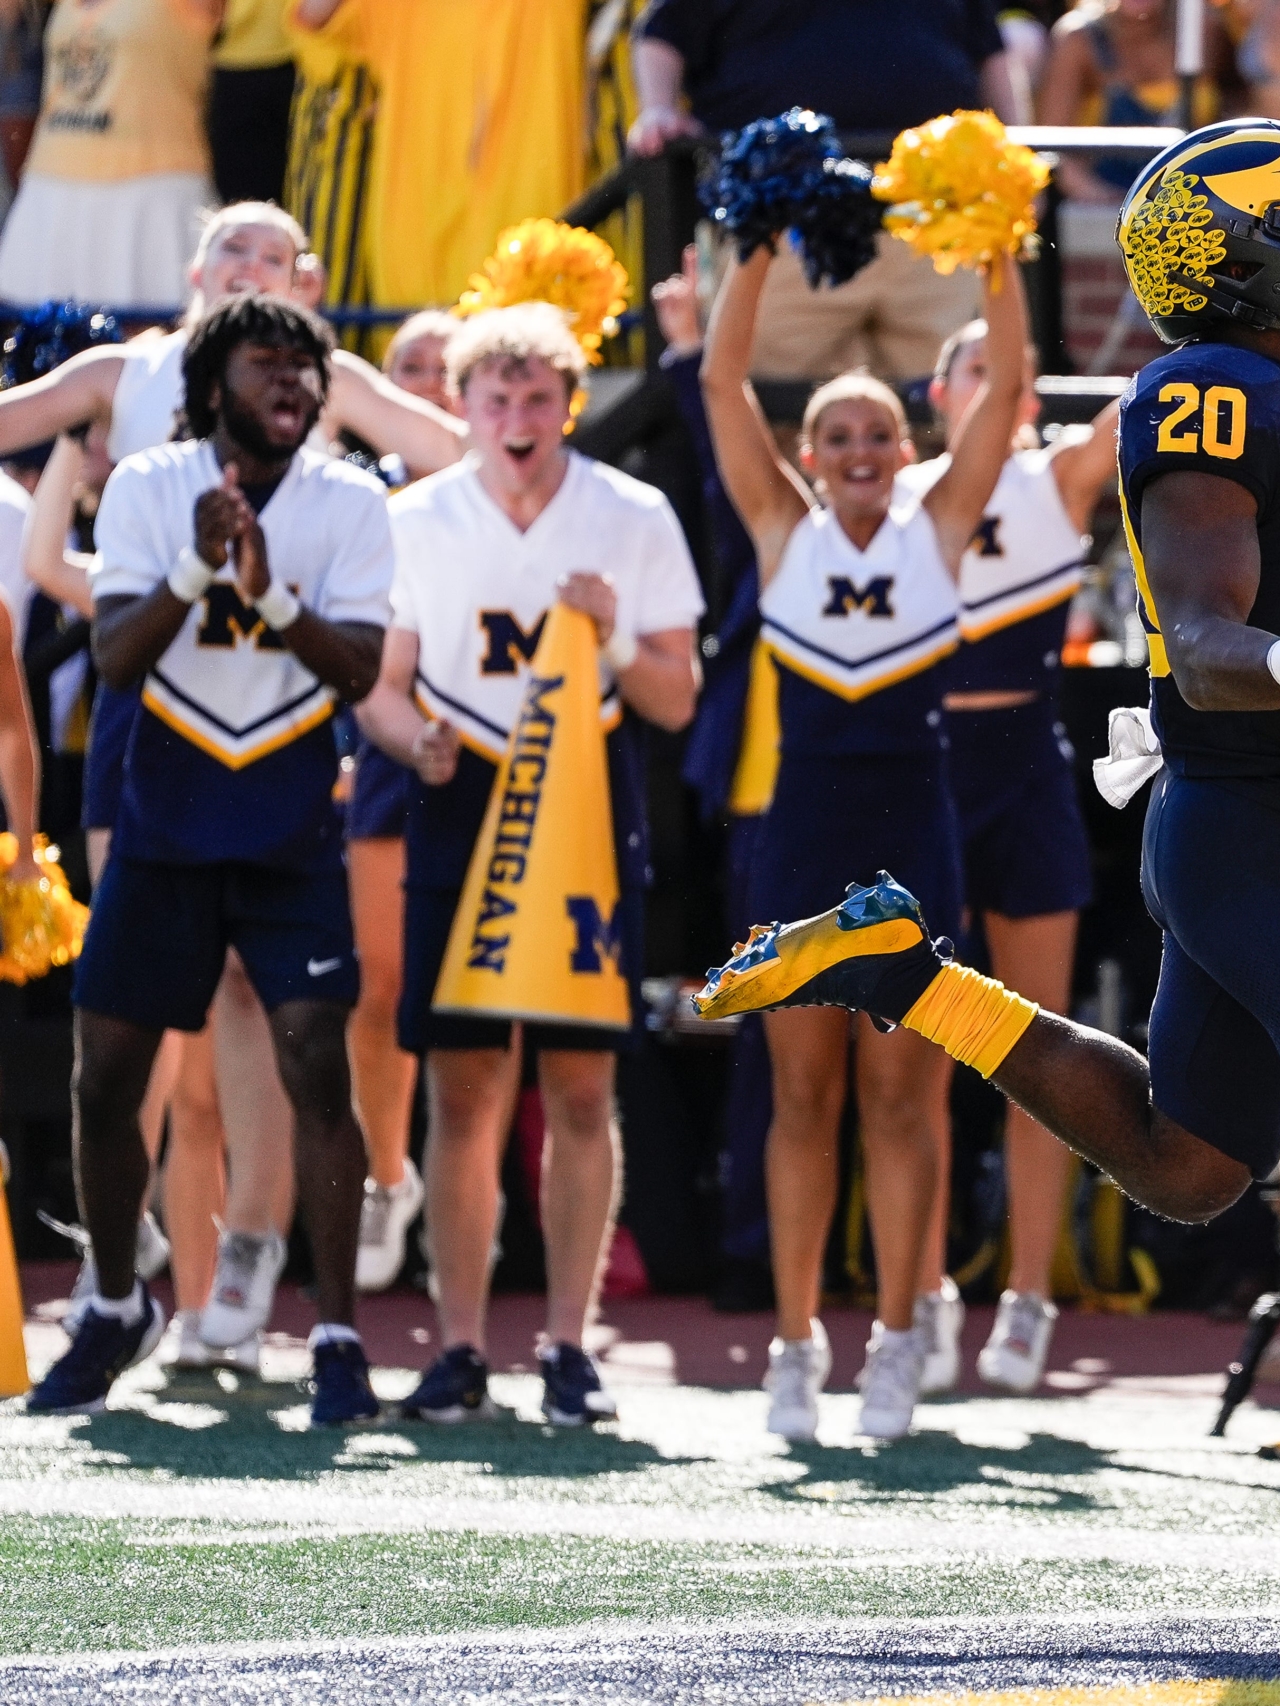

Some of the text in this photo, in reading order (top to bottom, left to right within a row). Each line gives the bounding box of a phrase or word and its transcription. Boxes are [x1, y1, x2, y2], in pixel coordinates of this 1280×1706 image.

[1157, 382, 1247, 460] 20
[196, 582, 299, 651] M
[823, 575, 895, 618] M
[479, 609, 552, 677] M
[467, 673, 566, 976] MICHIGAN
[565, 896, 627, 976] M
